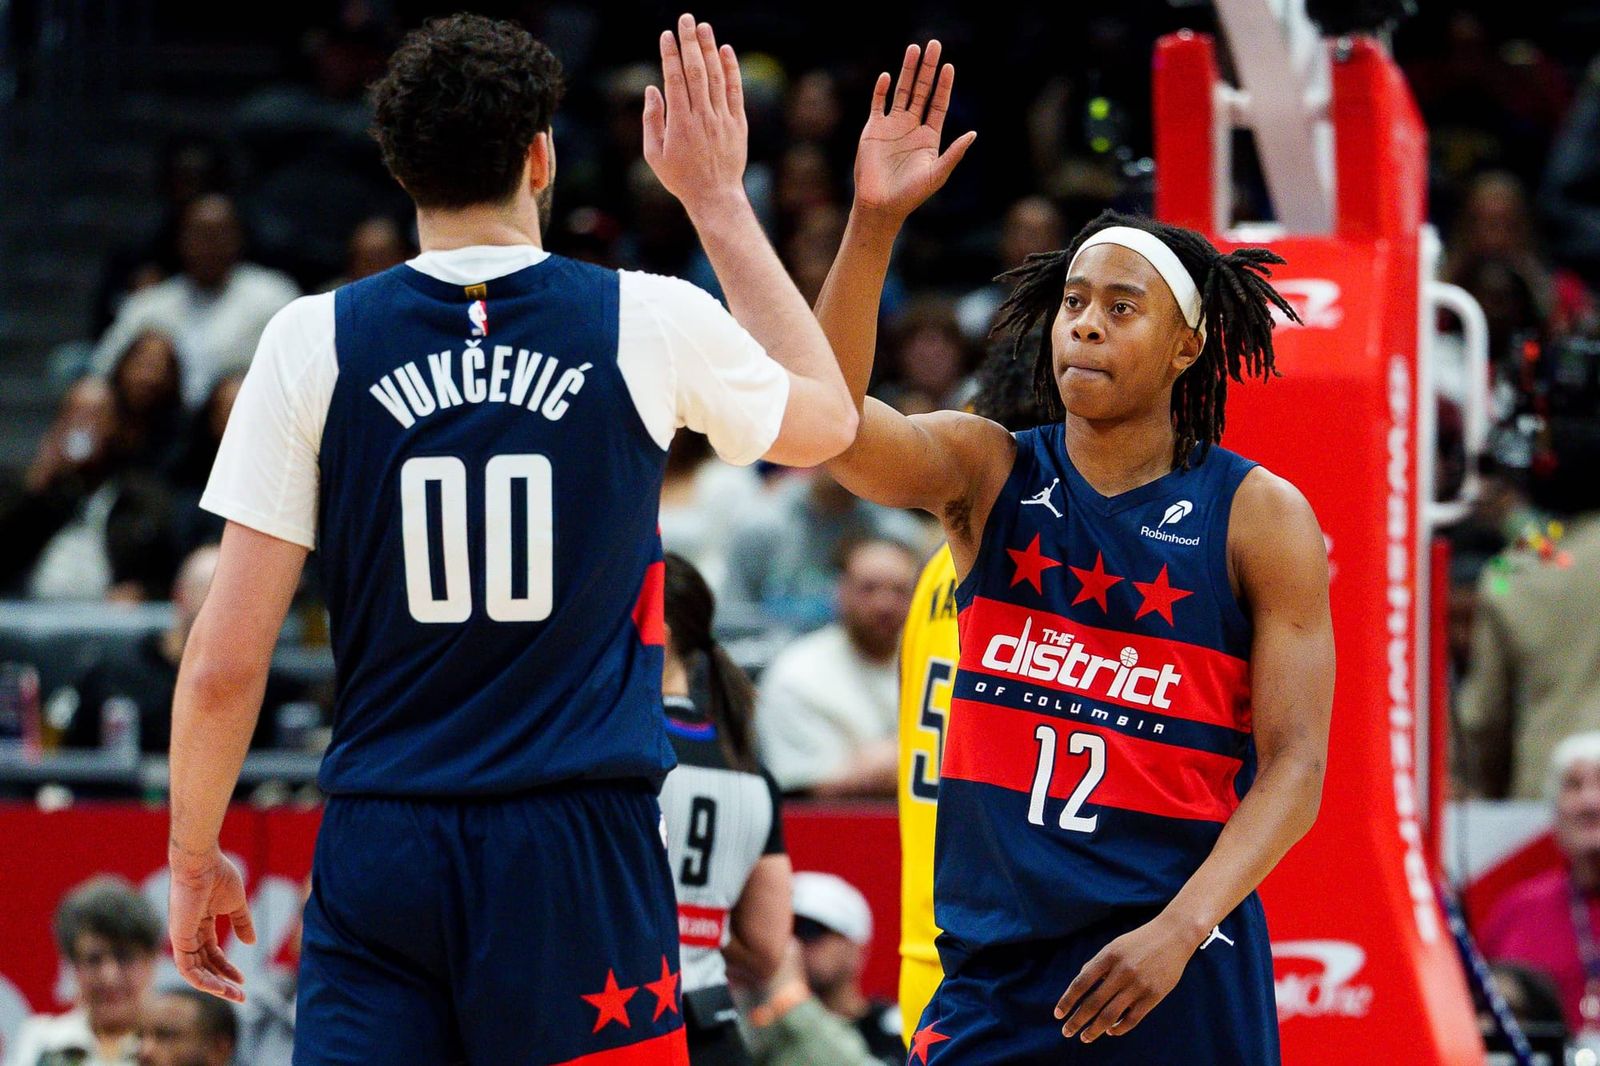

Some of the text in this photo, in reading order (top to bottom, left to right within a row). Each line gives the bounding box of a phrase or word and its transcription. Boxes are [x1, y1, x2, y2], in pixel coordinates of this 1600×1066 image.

[369, 338, 593, 430] VUKČEVIĆ
[400, 453, 553, 624] 00
[1140, 525, 1200, 546] Robinhood
[981, 615, 1182, 710] district
[1042, 628, 1075, 647] THE
[974, 681, 1165, 735] OF COLUMBIA
[1027, 725, 1106, 833] 12
[680, 796, 717, 887] 9
